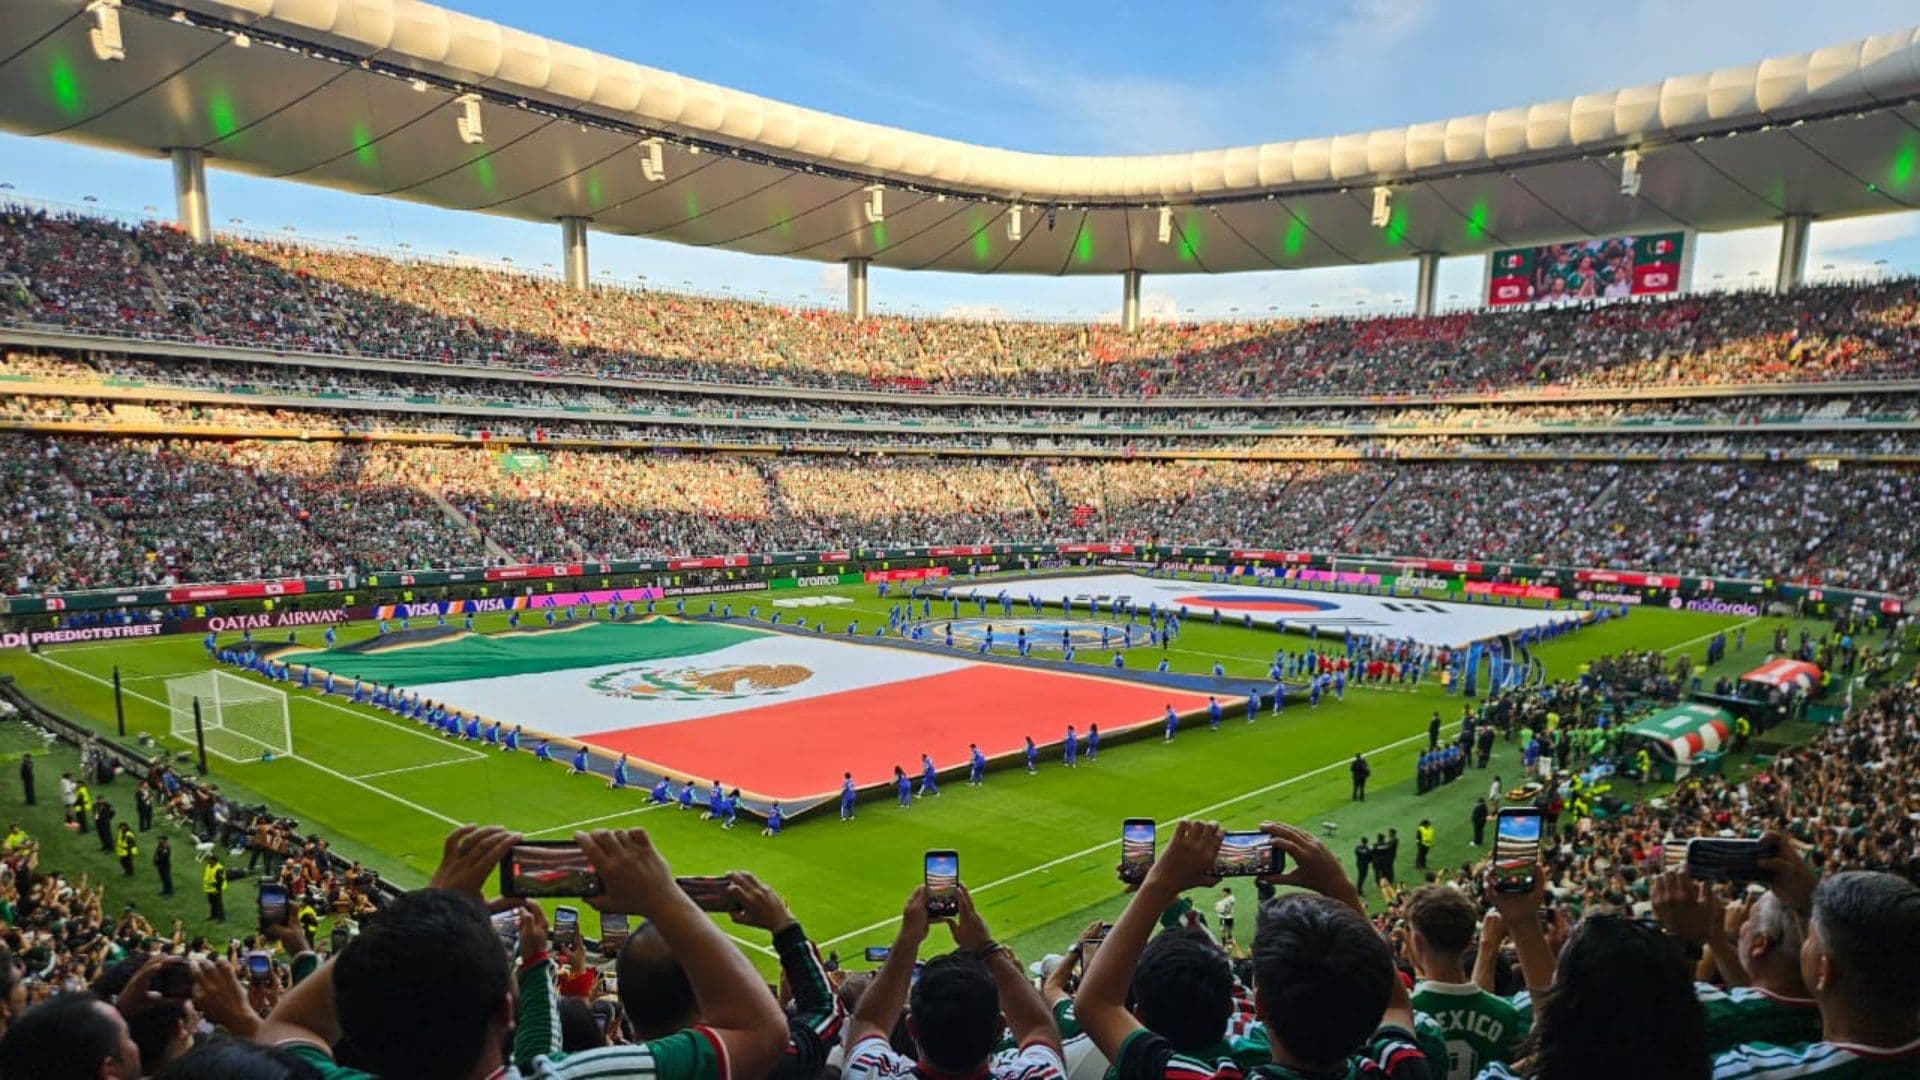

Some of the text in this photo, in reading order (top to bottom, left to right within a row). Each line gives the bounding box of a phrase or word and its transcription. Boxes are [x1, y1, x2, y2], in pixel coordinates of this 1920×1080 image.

[798, 575, 839, 587] aramco
[407, 602, 440, 617] VISA
[474, 598, 505, 611] VISA
[1687, 600, 1758, 616] motorola
[208, 614, 271, 632] QATAR
[31, 623, 163, 643] PREDICTSTREET
[1434, 1009, 1504, 1044] EXICO
